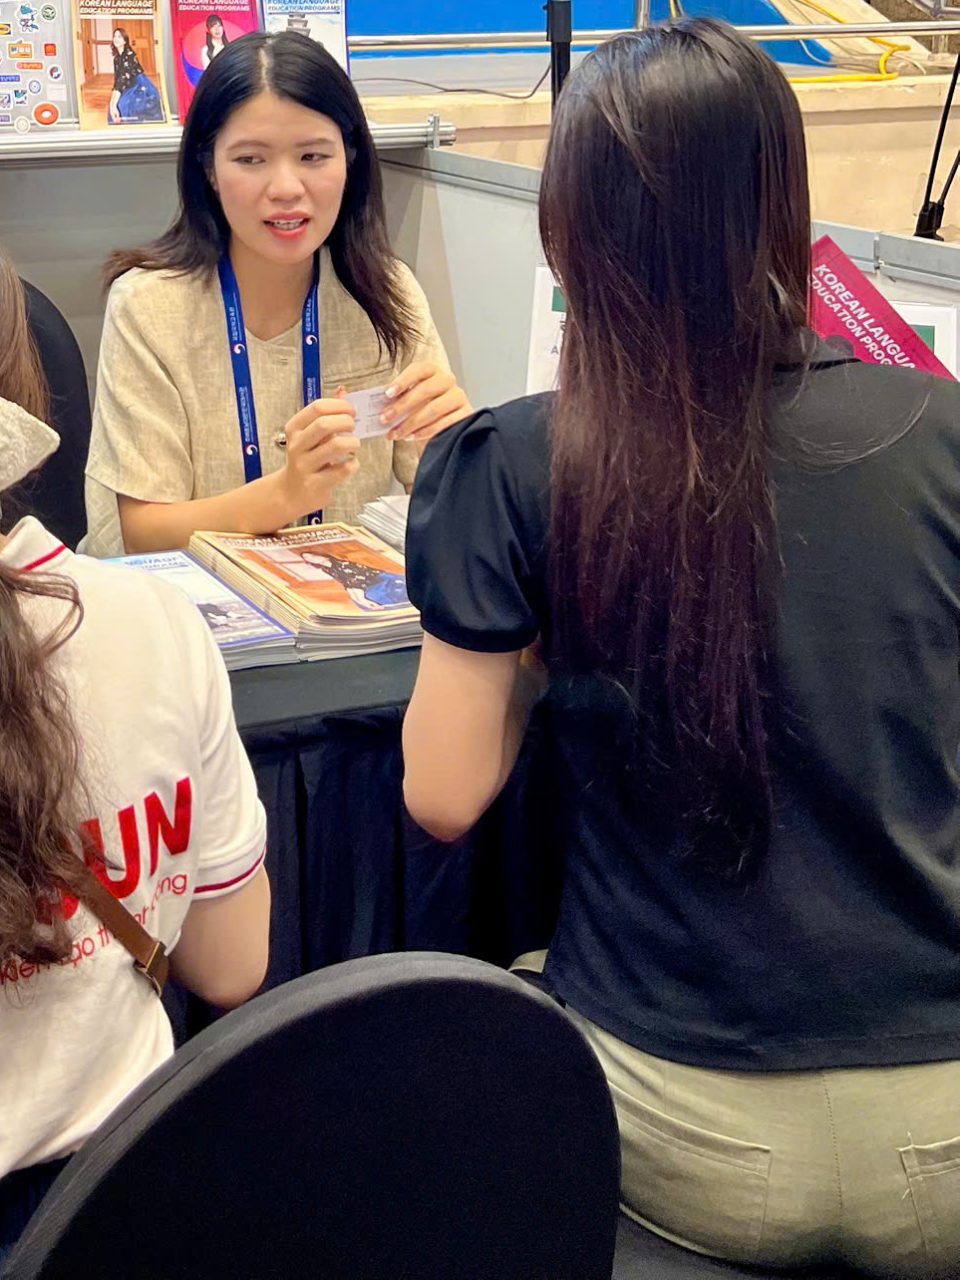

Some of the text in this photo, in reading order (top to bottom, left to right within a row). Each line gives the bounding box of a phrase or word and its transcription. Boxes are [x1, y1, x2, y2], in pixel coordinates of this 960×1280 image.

[79, 0, 152, 8] KOREAN LANGUAGE
[811, 273, 866, 337] DUCATION
[815, 264, 871, 320] KOREAN
